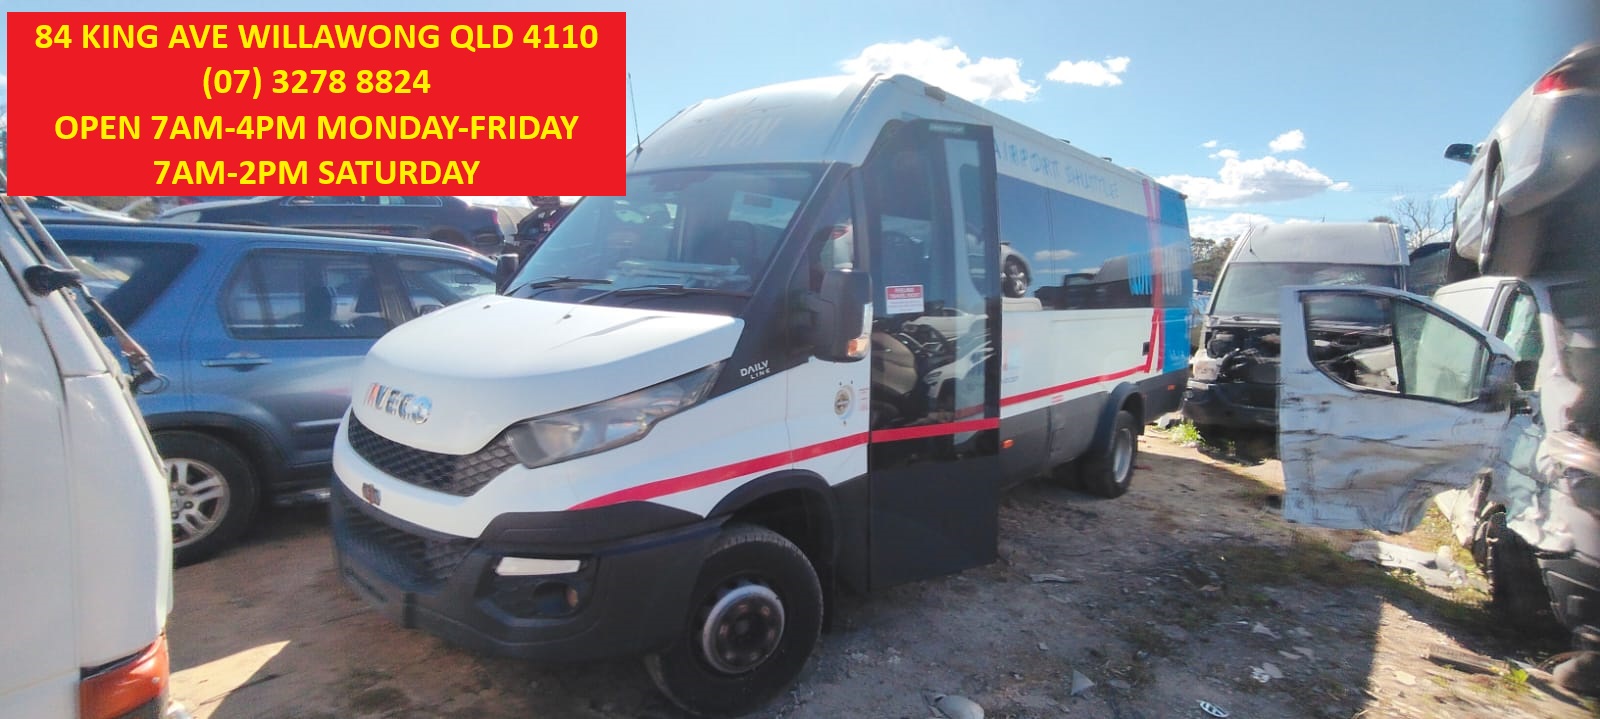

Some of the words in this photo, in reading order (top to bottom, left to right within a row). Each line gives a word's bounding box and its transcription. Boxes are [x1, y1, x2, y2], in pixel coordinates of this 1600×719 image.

[740, 360, 769, 377] DAILY
[750, 367, 771, 380] LINE
[365, 382, 433, 424] IVECO
